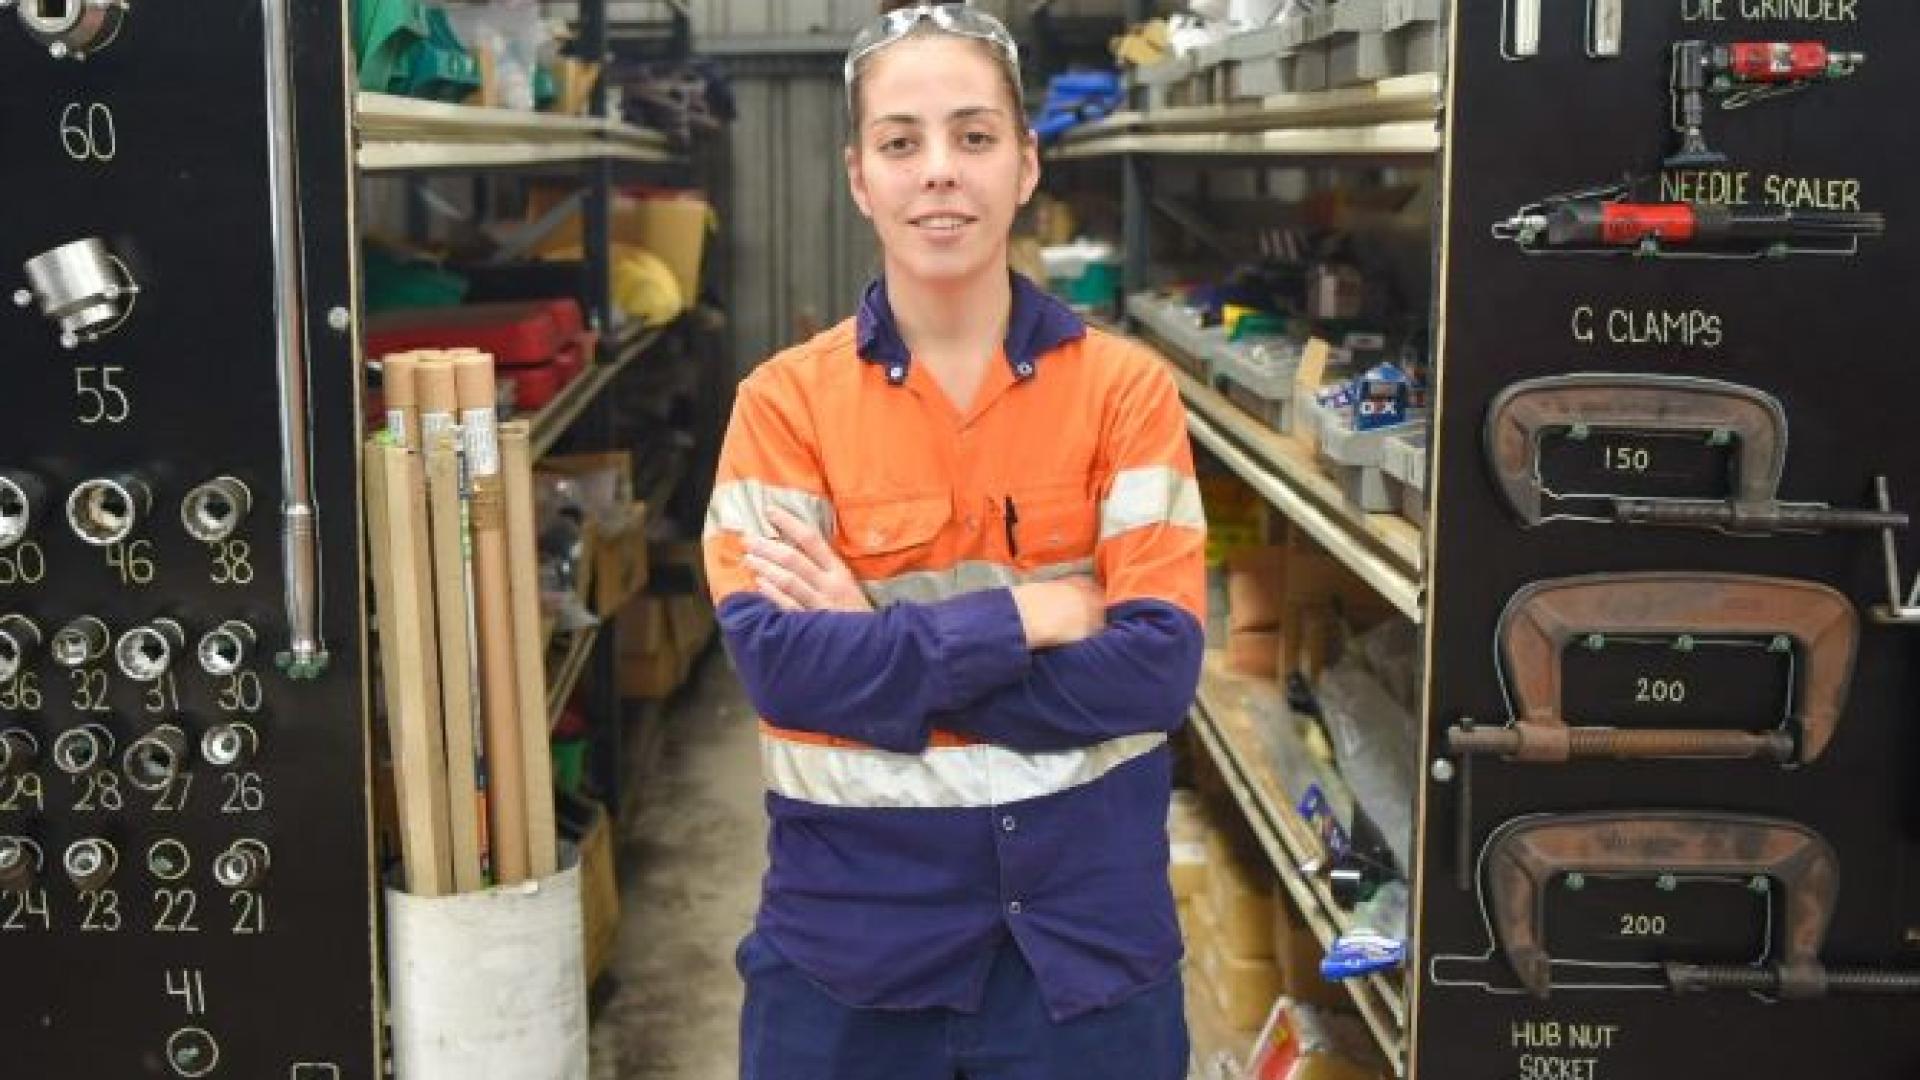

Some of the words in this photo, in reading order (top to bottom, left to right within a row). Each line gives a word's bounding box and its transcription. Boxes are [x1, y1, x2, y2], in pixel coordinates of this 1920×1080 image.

[1681, 0, 1726, 21] DIE
[1740, 0, 1858, 21] GRINDER
[60, 102, 116, 161] 60
[1659, 170, 1750, 205] NEEDLE
[1763, 174, 1861, 212] SCALER
[1571, 306, 1593, 341] G
[1607, 309, 1723, 348] CLAMPS
[75, 366, 130, 423] 55
[1605, 445, 1650, 472] 150
[105, 539, 155, 584] 46
[209, 539, 254, 584] 38
[0, 672, 42, 711] 36
[71, 668, 111, 711] 32
[146, 670, 179, 712] 31
[218, 670, 263, 712] 30
[1634, 676, 1685, 702] 200
[71, 769, 122, 812] 28
[220, 771, 266, 812] 26
[1, 888, 50, 931] 24
[77, 889, 122, 932] 23
[153, 887, 200, 932] 22
[229, 888, 263, 934] 21
[1619, 913, 1666, 936] 200
[165, 967, 205, 1015] 41
[1511, 1020, 1562, 1047] HUB
[1568, 1024, 1618, 1049] NUT
[1519, 1053, 1599, 1080] SOCKET
